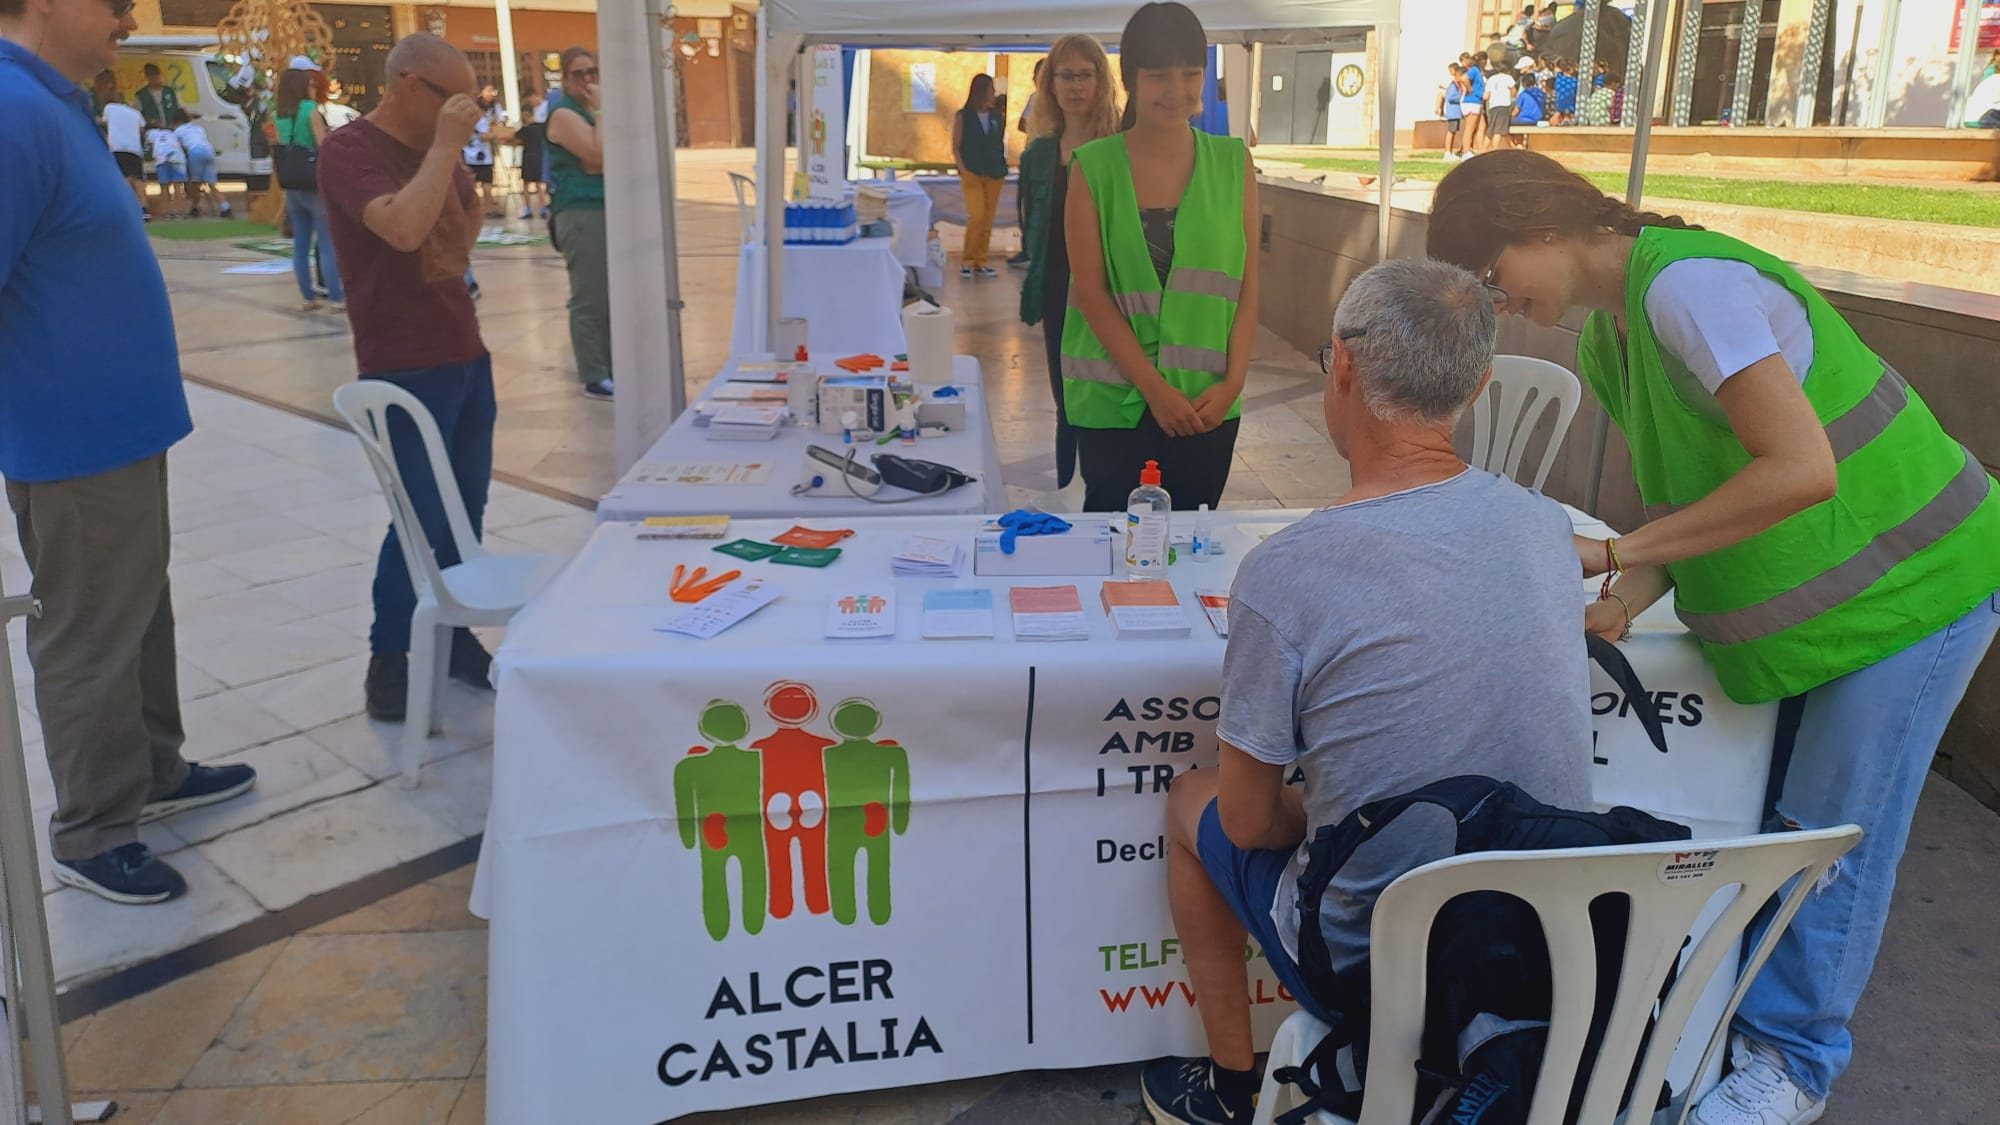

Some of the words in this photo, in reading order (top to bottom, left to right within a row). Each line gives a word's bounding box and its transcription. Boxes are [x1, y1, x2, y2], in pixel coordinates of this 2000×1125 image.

[1103, 695, 1221, 721] ASSO
[1099, 731, 1195, 755] AMB
[1096, 767, 1106, 797] I
[1096, 835, 1165, 864] Decl
[1665, 861, 1715, 871] MIRALLES
[704, 958, 895, 1020] ALCER
[657, 1015, 944, 1087] CASTALIA
